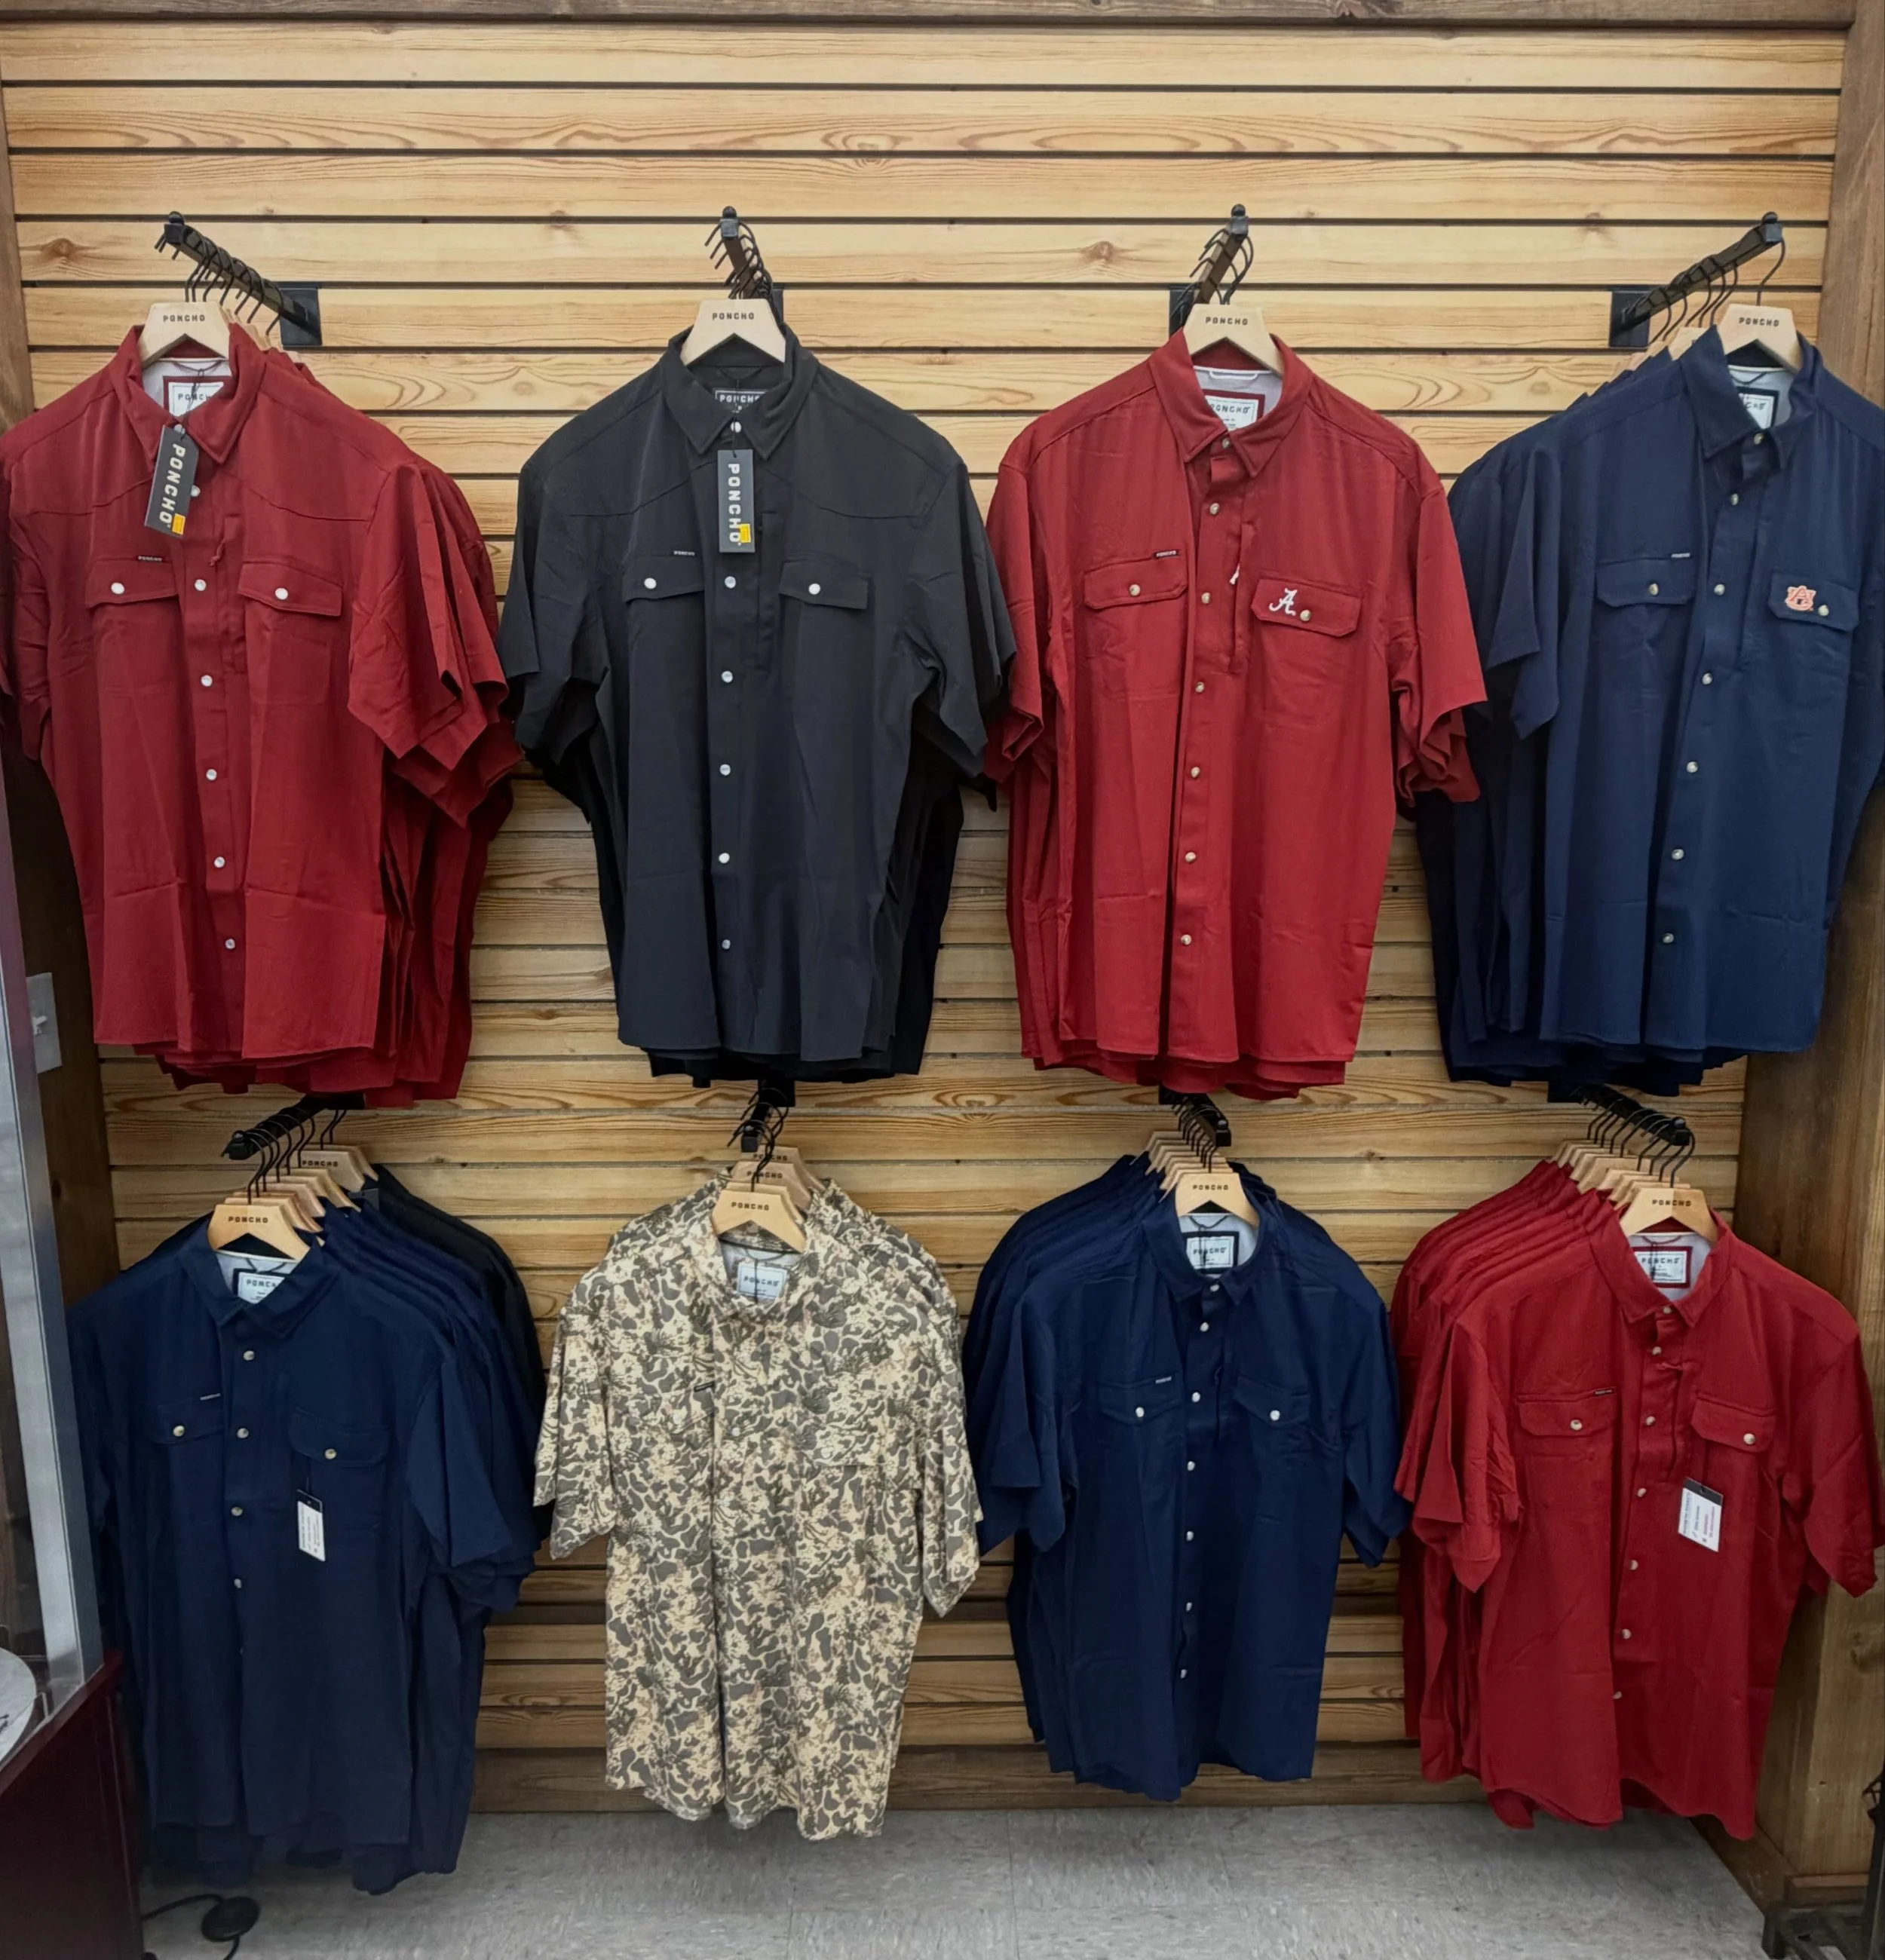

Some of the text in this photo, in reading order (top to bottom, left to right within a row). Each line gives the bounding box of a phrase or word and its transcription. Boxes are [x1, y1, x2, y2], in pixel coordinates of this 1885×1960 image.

[162, 314, 205, 323] PONCHO
[713, 312, 755, 320] PONCHO
[1205, 317, 1248, 326] PONCHO
[1739, 317, 1780, 326] PONCHO
[159, 443, 186, 527] PONCHO
[728, 463, 741, 545] PONCHO
[731, 1202, 770, 1211] PONCHO
